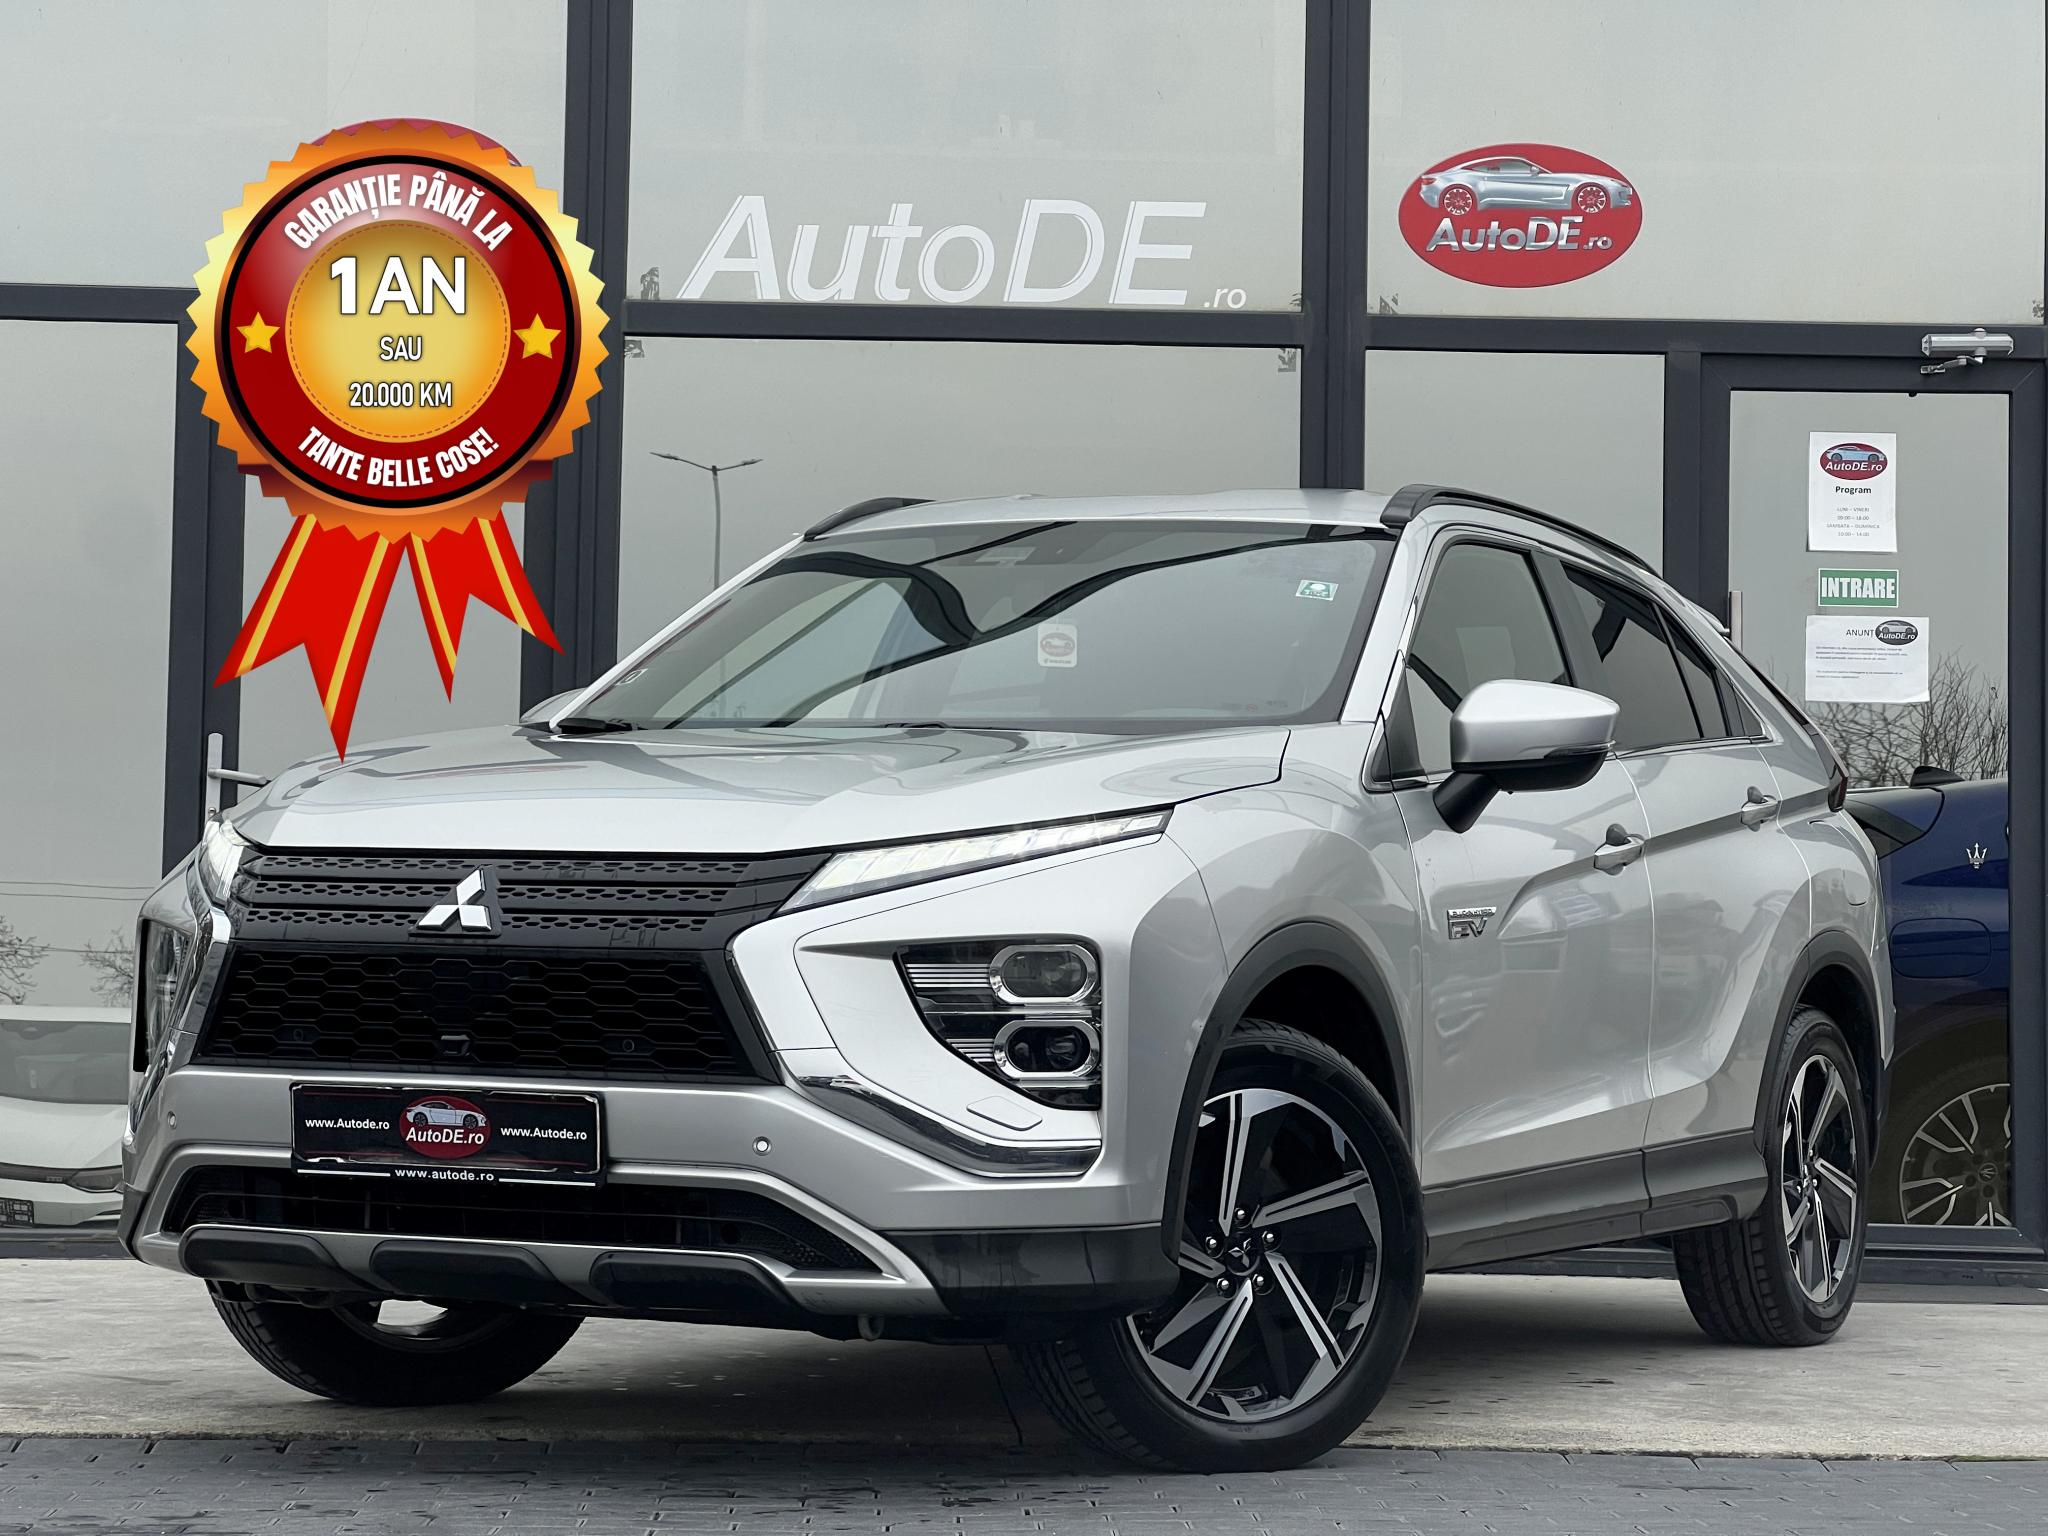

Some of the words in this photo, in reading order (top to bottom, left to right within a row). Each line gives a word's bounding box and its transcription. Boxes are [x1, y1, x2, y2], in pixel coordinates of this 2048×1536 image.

[1825, 460, 1883, 472] AutoDE.ro
[1835, 486, 1872, 495] Program
[1821, 577, 1896, 599] INTRARE
[1878, 632, 1916, 640] AutoDE.ro
[305, 1117, 390, 1130] www.Autode.ro
[405, 1126, 485, 1145] AutoDE.ro
[500, 1126, 588, 1141] www.Autode.ro
[394, 1168, 495, 1182] www.autode.ro
